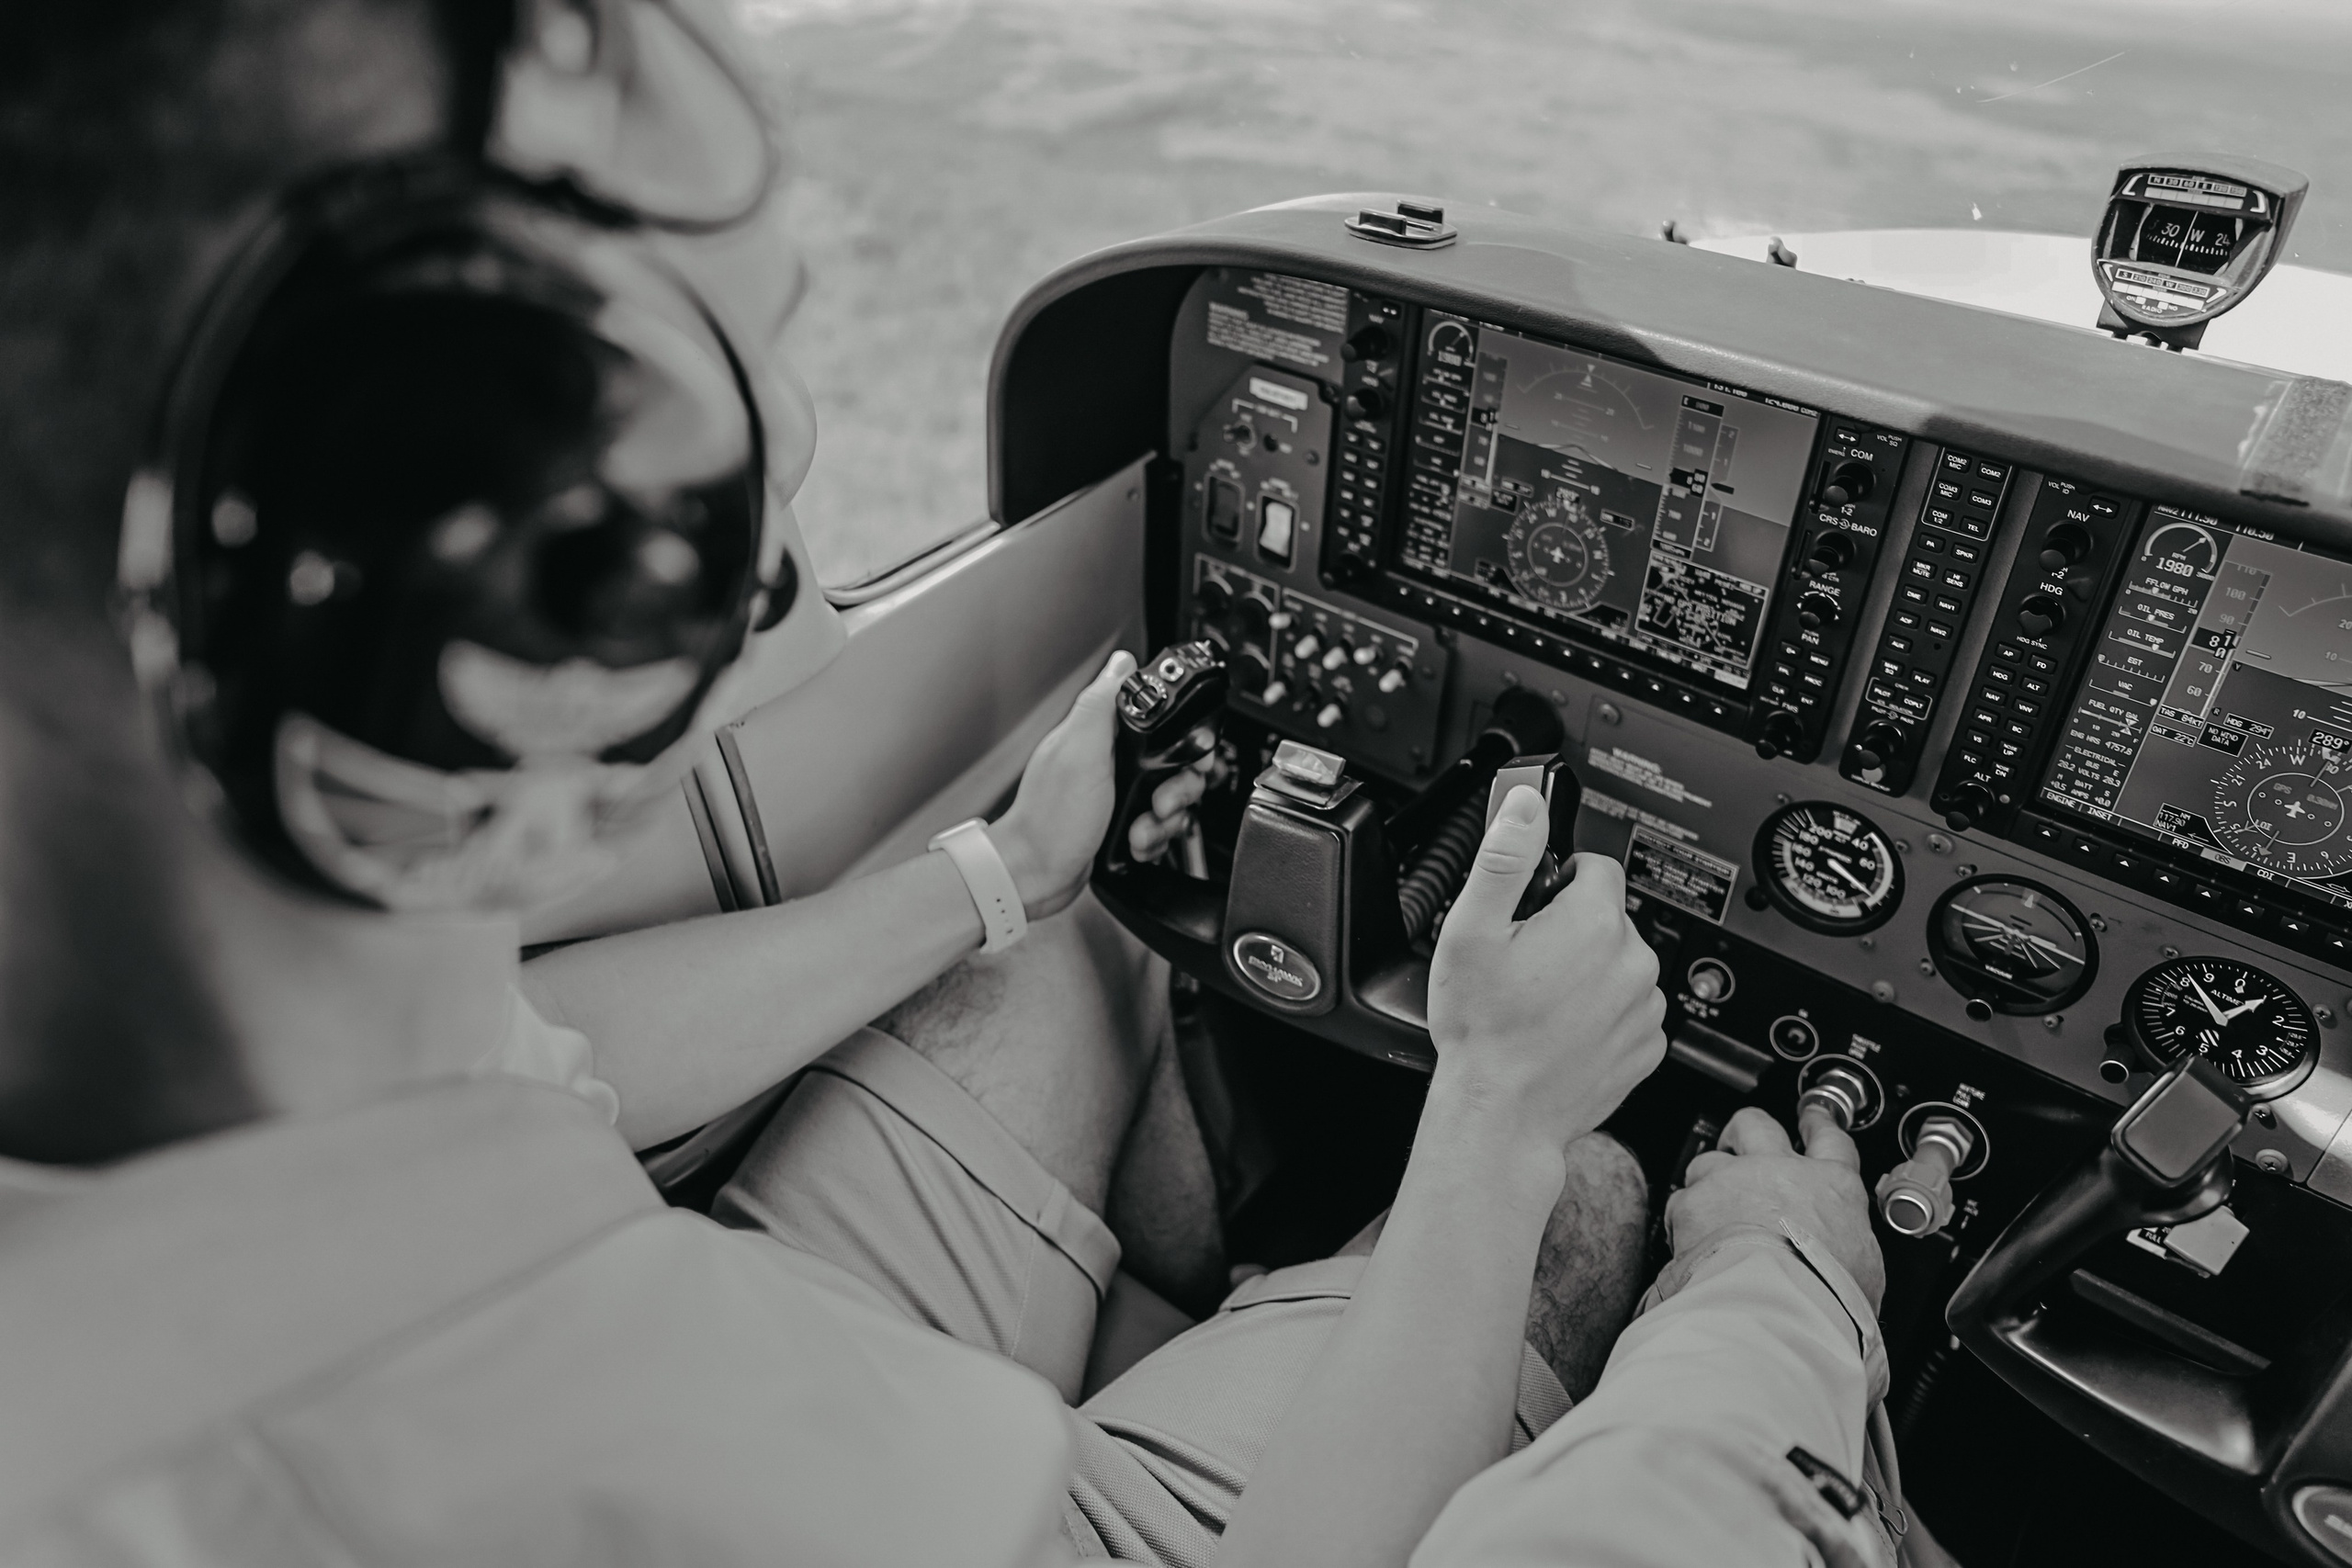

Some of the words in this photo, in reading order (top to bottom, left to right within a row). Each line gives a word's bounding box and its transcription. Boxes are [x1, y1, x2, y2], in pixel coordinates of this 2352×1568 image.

[2161, 222, 2180, 238] 30
[2190, 228, 2205, 243] W
[2215, 232, 2231, 246] 24
[2133, 274, 2147, 282] 210
[2148, 277, 2162, 286] 240
[2178, 284, 2191, 292] 300
[2142, 305, 2163, 313] RADIO
[1850, 448, 1873, 461] COM
[1948, 455, 1967, 465] COM2
[1949, 462, 1962, 470] MIC
[1981, 467, 2001, 478] COM2
[1939, 482, 1958, 493] COM3
[2048, 481, 2060, 490] VOL
[2061, 482, 2075, 491] PUSH
[1940, 490, 1953, 498] MIC
[1972, 495, 1992, 506] COM3
[1840, 506, 1853, 516] 1-2
[1932, 510, 1948, 519] COM
[2067, 509, 2090, 523] NAV
[1819, 513, 1838, 525] CRS
[1850, 524, 1877, 537] BARO
[1967, 524, 1979, 533] TEL
[1955, 548, 1973, 559] SPKR
[2171, 552, 2187, 560] RPM
[1917, 561, 1931, 570] MKR
[2155, 557, 2194, 578] 1980
[1913, 568, 1930, 578] MUTE
[1946, 577, 1964, 588] SENS
[2040, 581, 2064, 595] HDG
[2145, 577, 2171, 590] FFLOW
[2172, 585, 2188, 595] GPH
[1808, 581, 1840, 596] RANGE
[2225, 586, 2247, 601] 100
[1906, 590, 1921, 600] DME
[1939, 601, 1955, 611] NAV1
[2188, 607, 2198, 615] 20
[2137, 604, 2152, 614] OIL
[2154, 608, 2175, 620] PRES
[1899, 616, 1913, 625] ADF
[2219, 613, 2235, 626] 90
[1929, 626, 1948, 637] NAV2
[2127, 628, 2142, 638] OIL
[2145, 633, 2164, 644] TEMP
[1801, 632, 1819, 645] PAN
[2017, 636, 2030, 645] HDG
[2030, 640, 2048, 650] SYNC
[1891, 640, 1905, 649] AUX
[1810, 655, 1829, 667] MENU
[2127, 656, 2143, 666] EGT
[2324, 651, 2338, 661] 10
[1883, 661, 1899, 671] MAN
[2036, 660, 2047, 669] FD
[2199, 661, 2213, 674] 70
[1915, 674, 1931, 684] PLAY
[1993, 671, 2007, 681] HDG
[1771, 685, 1785, 695] CLR
[2027, 682, 2040, 691] ALT
[2118, 680, 2132, 691] VAC
[2187, 684, 2202, 697] 60
[1873, 687, 1892, 698] PILOT
[1985, 692, 2000, 702] NAV
[1781, 701, 1799, 714] FMS
[1904, 697, 1925, 709] COPLT
[2018, 704, 2033, 714] VNV
[2088, 699, 2107, 711] FUEL
[2109, 705, 2124, 716] QTY
[2125, 711, 2140, 721] GAL
[2292, 708, 2306, 720] 10
[1977, 714, 1992, 723] APR
[2160, 706, 2176, 717] TAS
[2181, 714, 2202, 728] 84KT
[2012, 726, 2022, 734] BC
[2152, 725, 2167, 735] OAT
[2226, 716, 2243, 728] HDG
[2249, 723, 2273, 736] 294°
[1973, 735, 1982, 743] VS
[2070, 728, 2086, 739] ENG
[2086, 735, 2101, 745] HRS
[2208, 727, 2219, 736] NO
[2220, 731, 2239, 742] WIND
[2211, 736, 2230, 747] DATA
[2312, 731, 2350, 750] 289°
[1963, 754, 1977, 764] FLC
[2074, 746, 2117, 767] ELECTRICAL
[2290, 753, 2306, 766] W
[2085, 760, 2100, 770] BUS
[2112, 769, 2120, 777] E
[2256, 758, 2272, 770] 24
[1973, 772, 1992, 783] ALT
[1995, 770, 2007, 778] DN
[2077, 767, 2101, 781] VOLTS
[2074, 779, 2093, 791] BATT
[2231, 774, 2246, 786] 21
[2070, 788, 2090, 800] AMPS
[2273, 783, 2292, 795] GPS
[2046, 791, 2076, 808] ENGINE
[2087, 807, 2113, 821] INSET
[2223, 800, 2237, 808] S
[2159, 812, 2187, 827] 117.90
[2179, 812, 2191, 820] NM
[2155, 819, 2177, 832] NAV1
[1851, 838, 1869, 851] 40
[2172, 838, 2189, 850] PFD
[2214, 853, 2232, 864] OBS
[2287, 852, 2296, 863] E
[2256, 869, 2275, 881] CDI
[2179, 976, 2190, 987] 8
[2203, 973, 2215, 983] 9
[2211, 989, 2244, 1006] ALTIME
[2165, 1006, 2176, 1017] 7
[2272, 1015, 2285, 1027] 2
[2175, 1025, 2186, 1035] 6
[2199, 1043, 2209, 1054] 5
[2231, 1049, 2243, 1059] 4
[2256, 1044, 2268, 1056] 3
